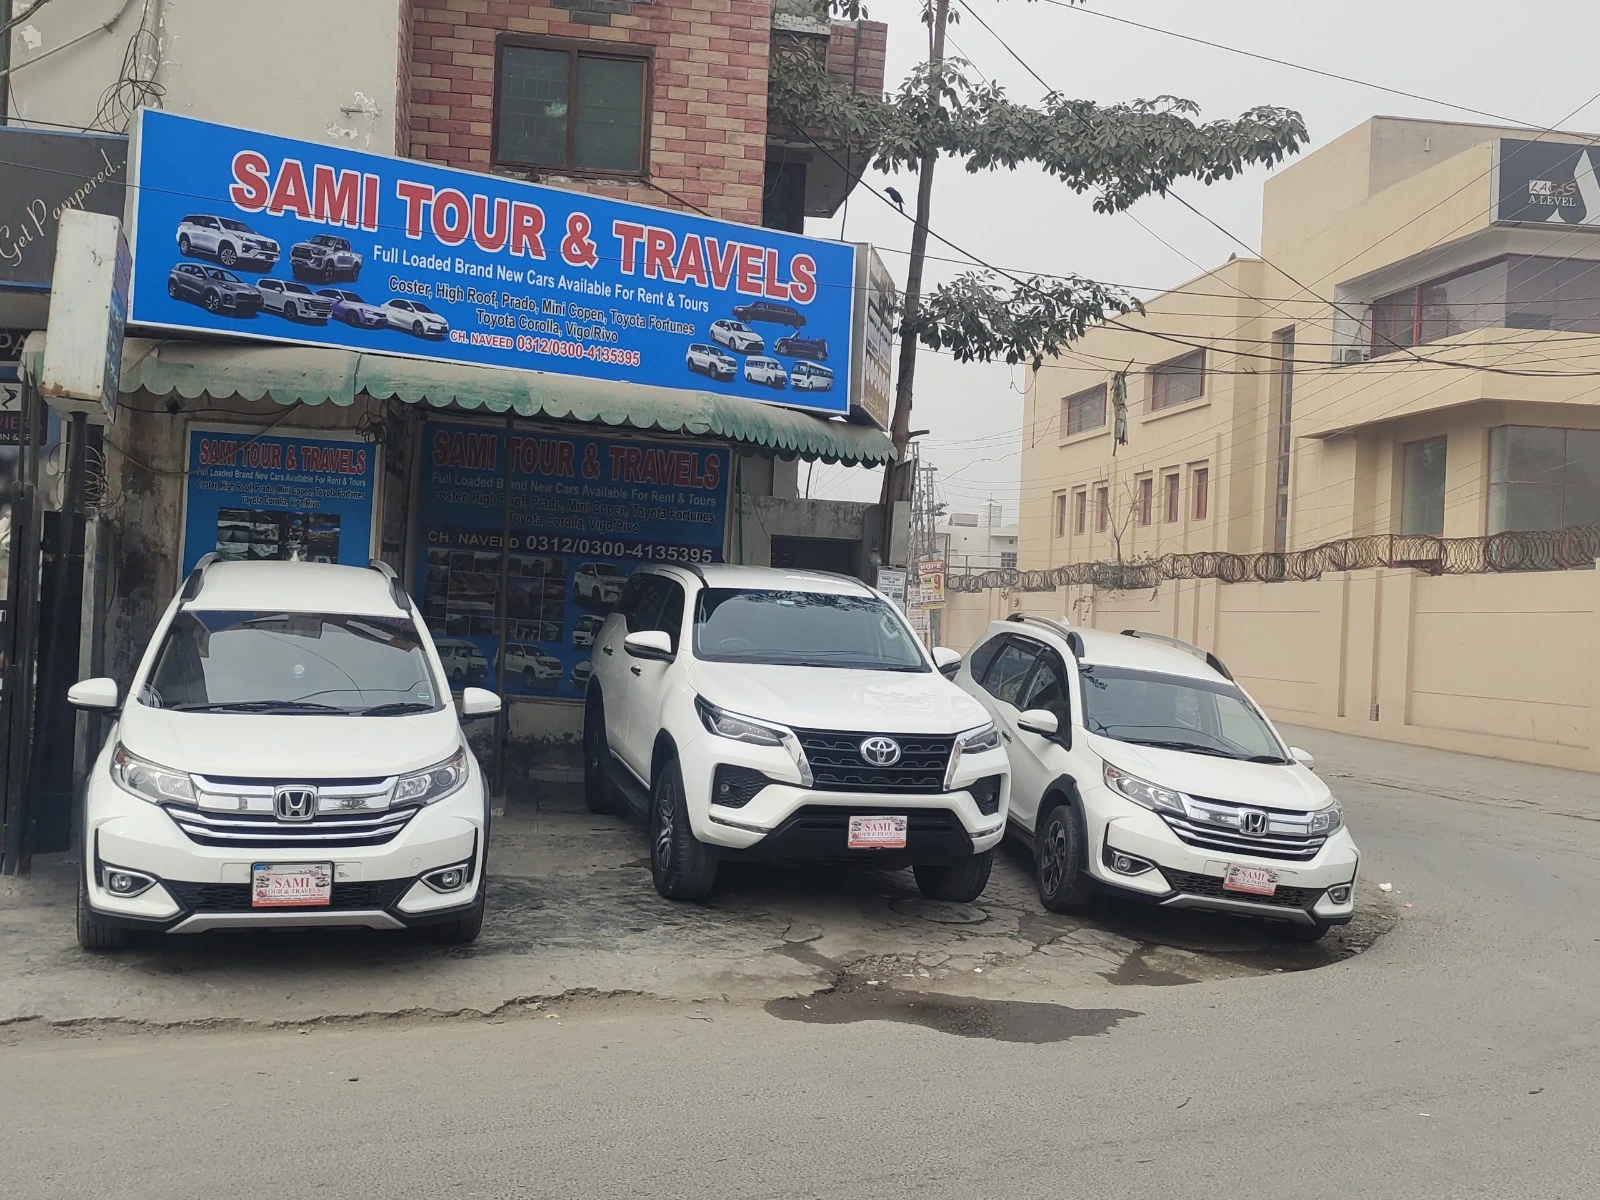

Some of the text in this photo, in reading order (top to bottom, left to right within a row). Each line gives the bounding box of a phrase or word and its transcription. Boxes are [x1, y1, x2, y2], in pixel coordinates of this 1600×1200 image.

[1528, 195, 1576, 207] A LEVEL
[229, 150, 817, 305] SAMI TOUR & TRAVELS
[373, 244, 709, 312] Full Loaded Brand New Cars Available For Rent & Tours
[388, 275, 695, 336] Coster, High Roof, Prado, Mini Copen, Toyota Fortunes
[476, 309, 618, 343] Toyota Corolla, Vigo/Rivo
[450, 329, 640, 367] CH. NAVEED 0312/0300-4135395
[199, 438, 366, 475] SAMI TOUR & TRAVELS
[432, 430, 721, 490] SAMI TOUR & TRAVELS
[210, 469, 234, 478] Loaded
[235, 470, 253, 479] Brand
[255, 471, 268, 480] New
[270, 472, 285, 481] Cars
[285, 473, 313, 484] Available
[315, 475, 326, 484] For
[327, 475, 341, 485] Rent
[342, 477, 347, 486] &
[349, 477, 366, 487] Tours
[315, 487, 337, 499] Toyota
[432, 472, 452, 484] Full
[454, 474, 493, 488] Loaded
[530, 481, 552, 493] New
[555, 482, 580, 495] Cars
[582, 485, 627, 499] Available
[631, 489, 649, 500] For
[652, 490, 674, 502] Rent
[677, 492, 685, 504] &
[689, 493, 716, 507] Tours
[471, 490, 497, 508] High
[530, 495, 565, 514] Prado,
[567, 499, 591, 513] Mini
[632, 504, 667, 520] Toyota
[669, 507, 715, 523] Fortunes
[509, 511, 640, 535] Toyota Corolla, Vigo/Rivo
[428, 531, 453, 543] CH.
[526, 535, 713, 563] 0312/0300-4135395
[865, 823, 891, 831] SAMI
[274, 878, 310, 889] SAMI
[1241, 870, 1265, 881] SAMI
